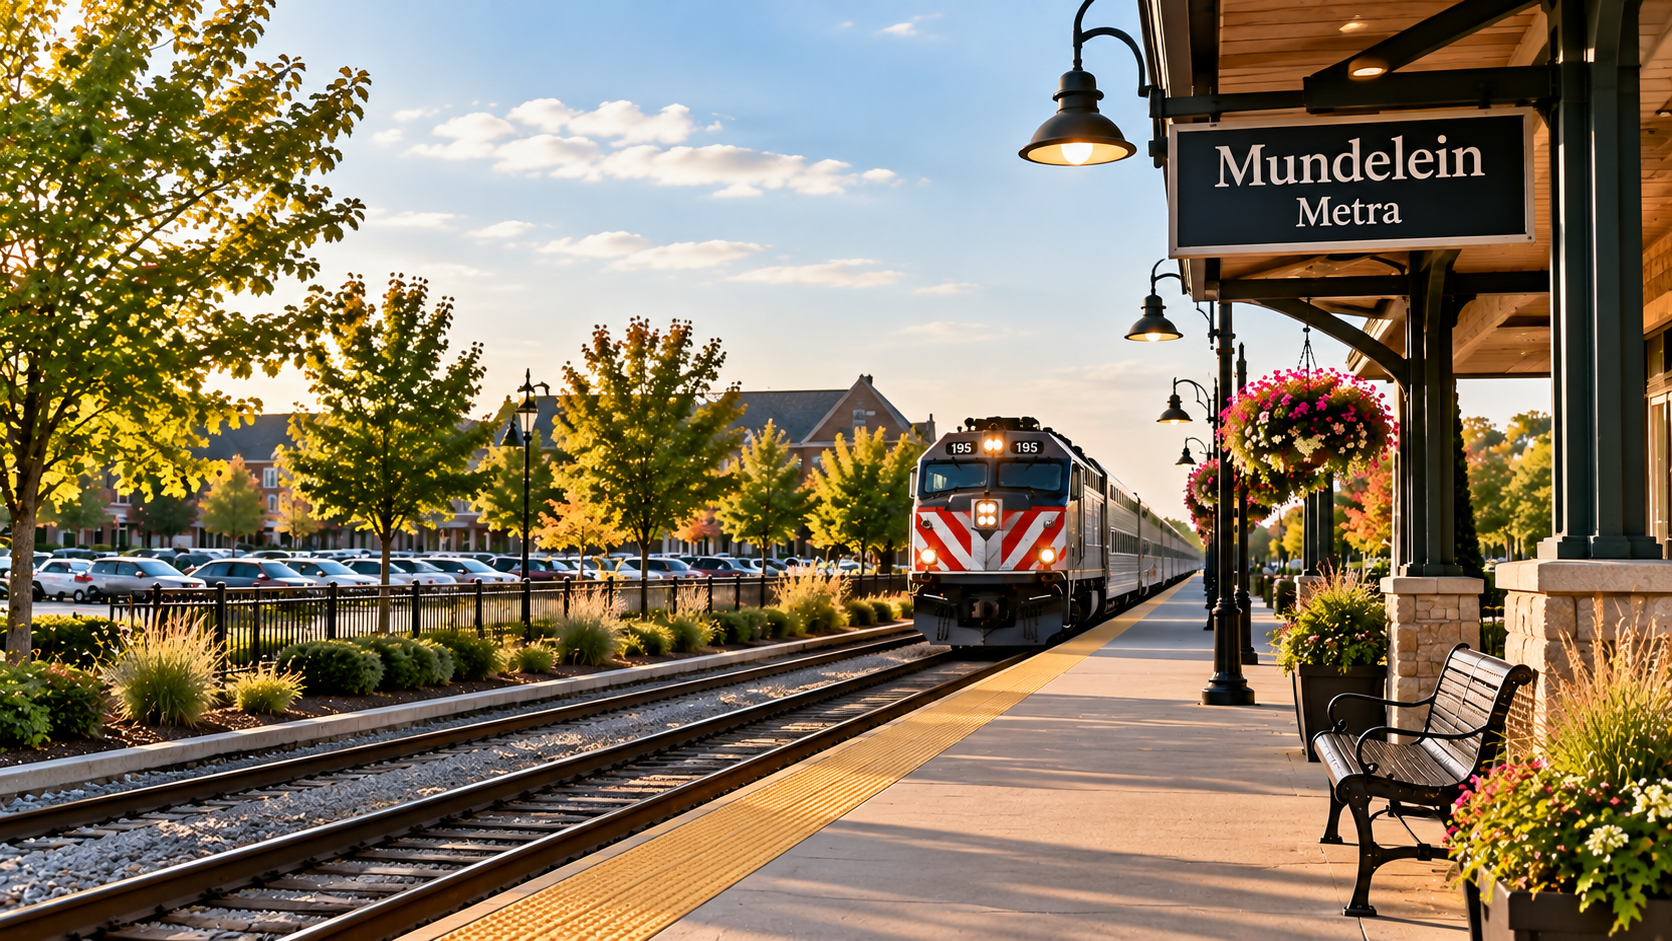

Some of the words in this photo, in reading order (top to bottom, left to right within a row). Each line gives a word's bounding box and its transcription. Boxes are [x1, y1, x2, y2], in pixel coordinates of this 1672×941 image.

[1214, 134, 1486, 188] Mundelein
[1296, 196, 1403, 228] Metra
[951, 442, 972, 454] 195
[1016, 442, 1038, 453] 195
